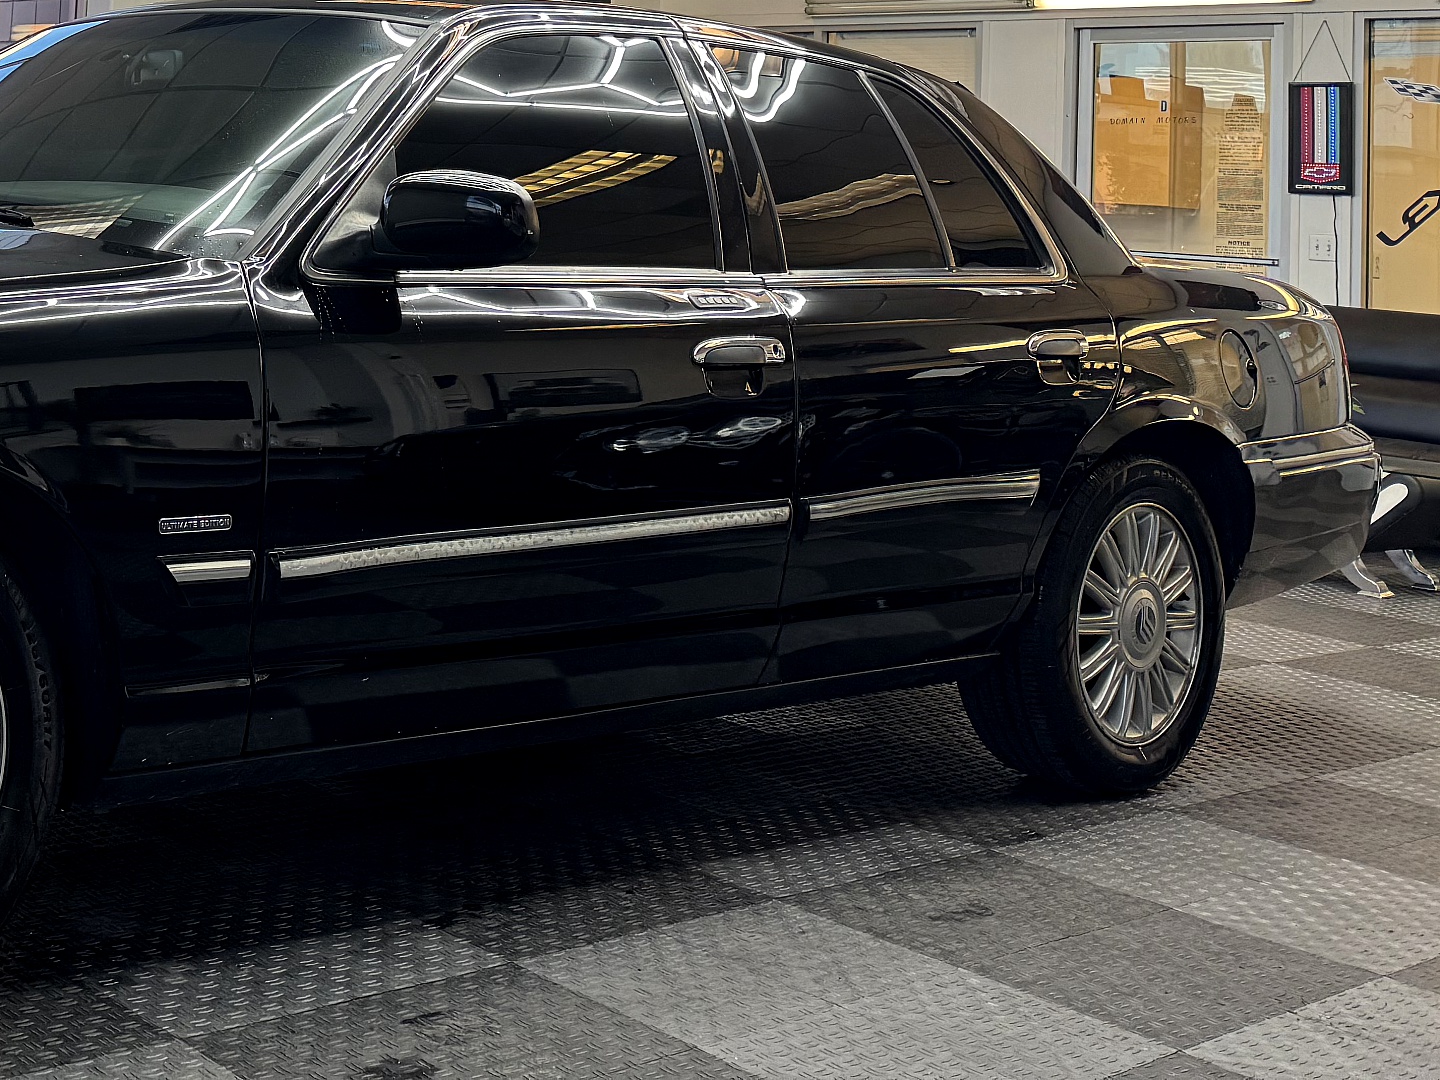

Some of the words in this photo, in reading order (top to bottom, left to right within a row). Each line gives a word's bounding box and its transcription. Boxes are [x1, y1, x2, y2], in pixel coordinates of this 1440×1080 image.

[1110, 117, 1146, 125] DOMAIN
[1156, 116, 1197, 125] MOTORS
[161, 521, 198, 530] ULTIMATE
